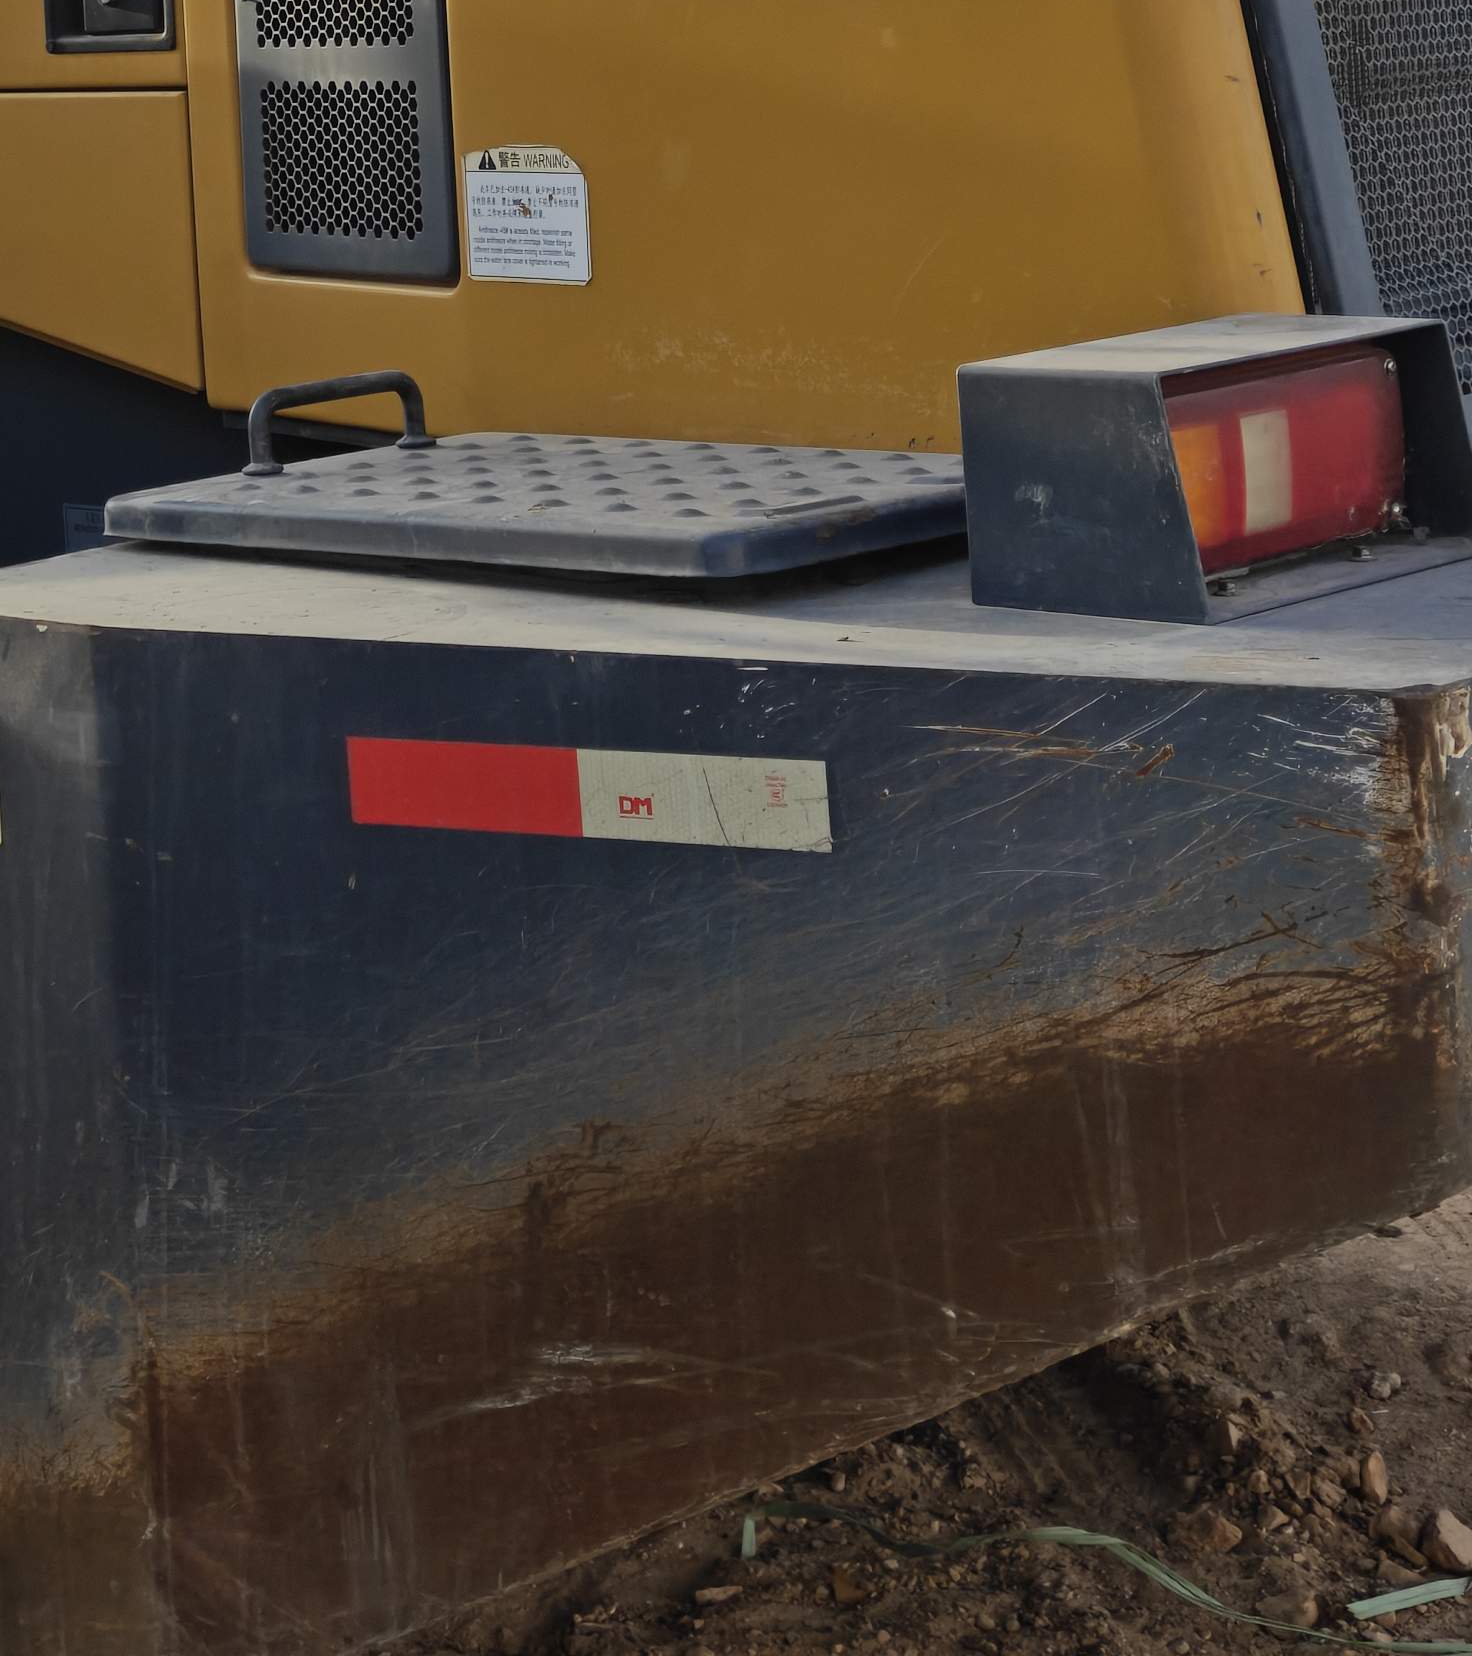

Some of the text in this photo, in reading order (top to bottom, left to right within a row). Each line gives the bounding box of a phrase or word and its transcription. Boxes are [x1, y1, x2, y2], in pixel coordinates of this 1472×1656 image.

[499, 151, 570, 169] 警告 WARNING
[619, 795, 653, 817] DM
